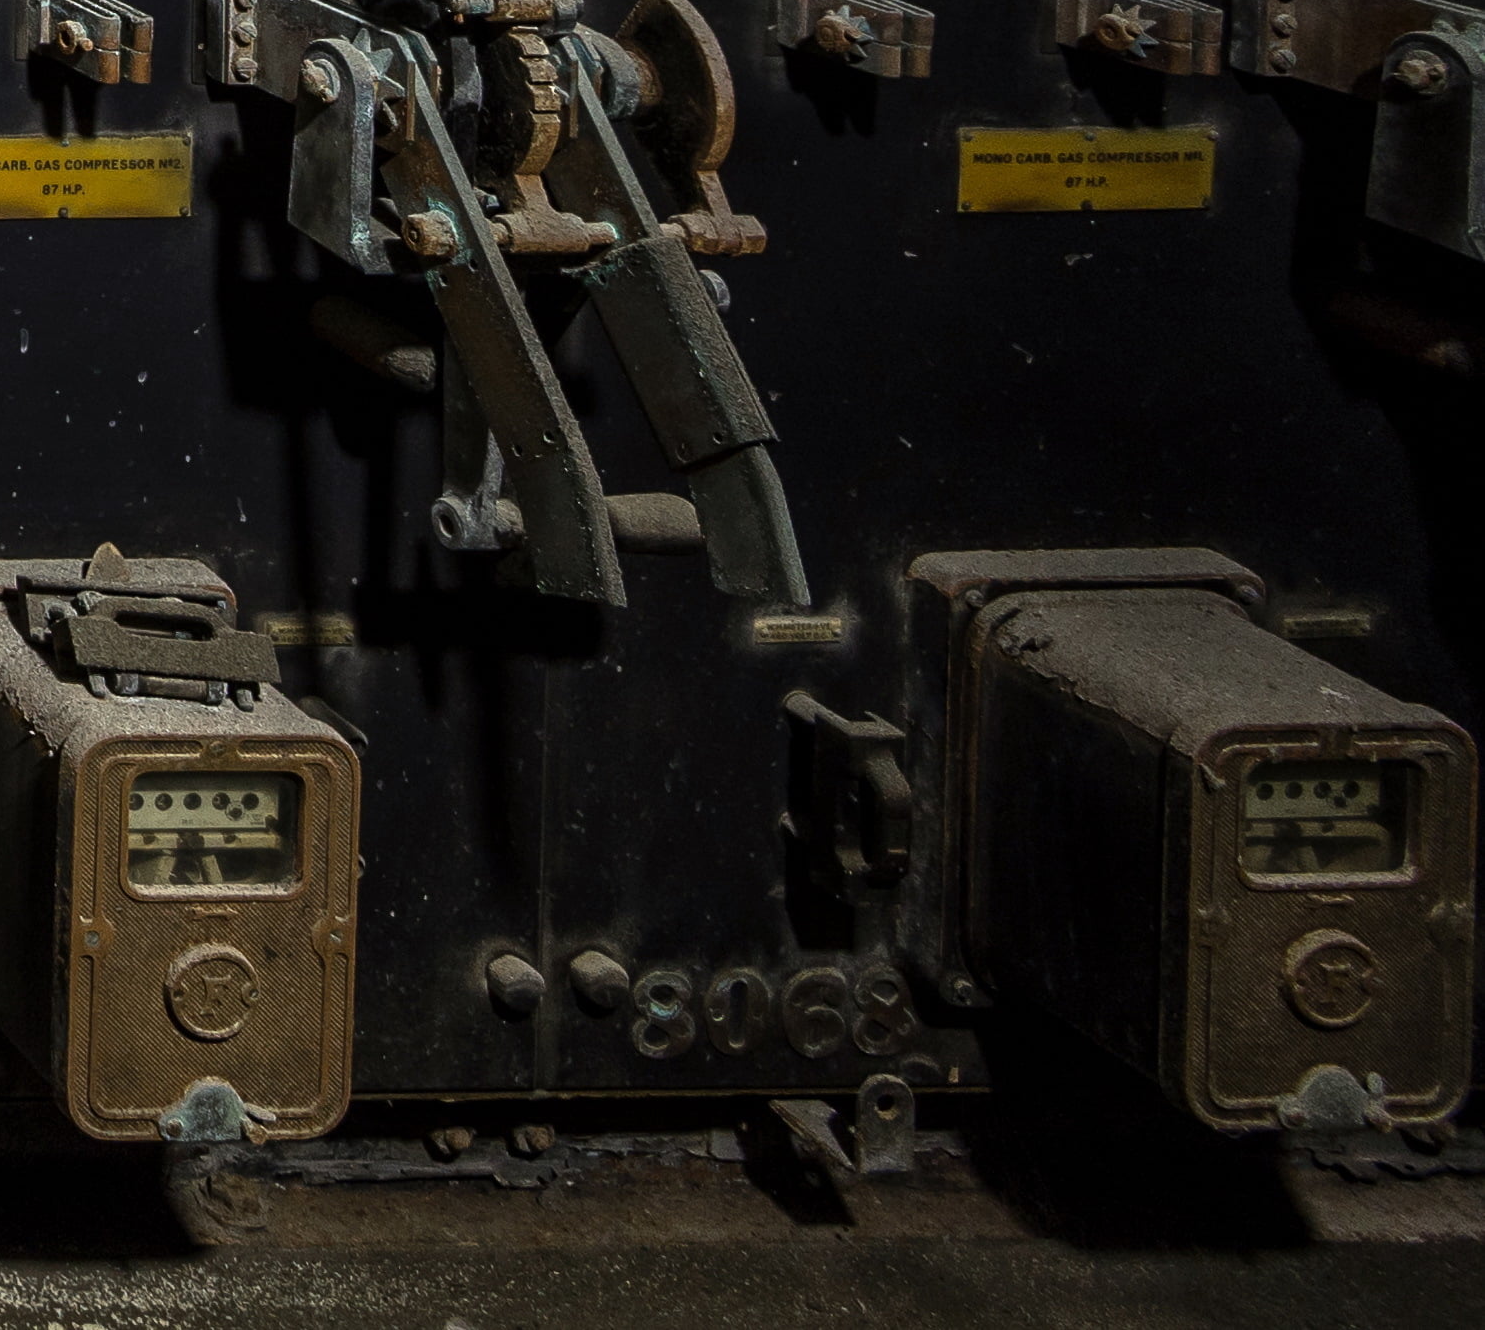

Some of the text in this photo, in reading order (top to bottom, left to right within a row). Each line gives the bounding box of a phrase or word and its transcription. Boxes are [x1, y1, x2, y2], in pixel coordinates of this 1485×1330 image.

[34, 159, 61, 171] GAS
[65, 158, 155, 171] COMPRESSOR
[972, 151, 1179, 165] MONO CARB. GAS COMPRESSOR
[41, 184, 86, 196] 87 H.P.
[201, 974, 233, 1017] F
[632, 965, 917, 1061] 8068
